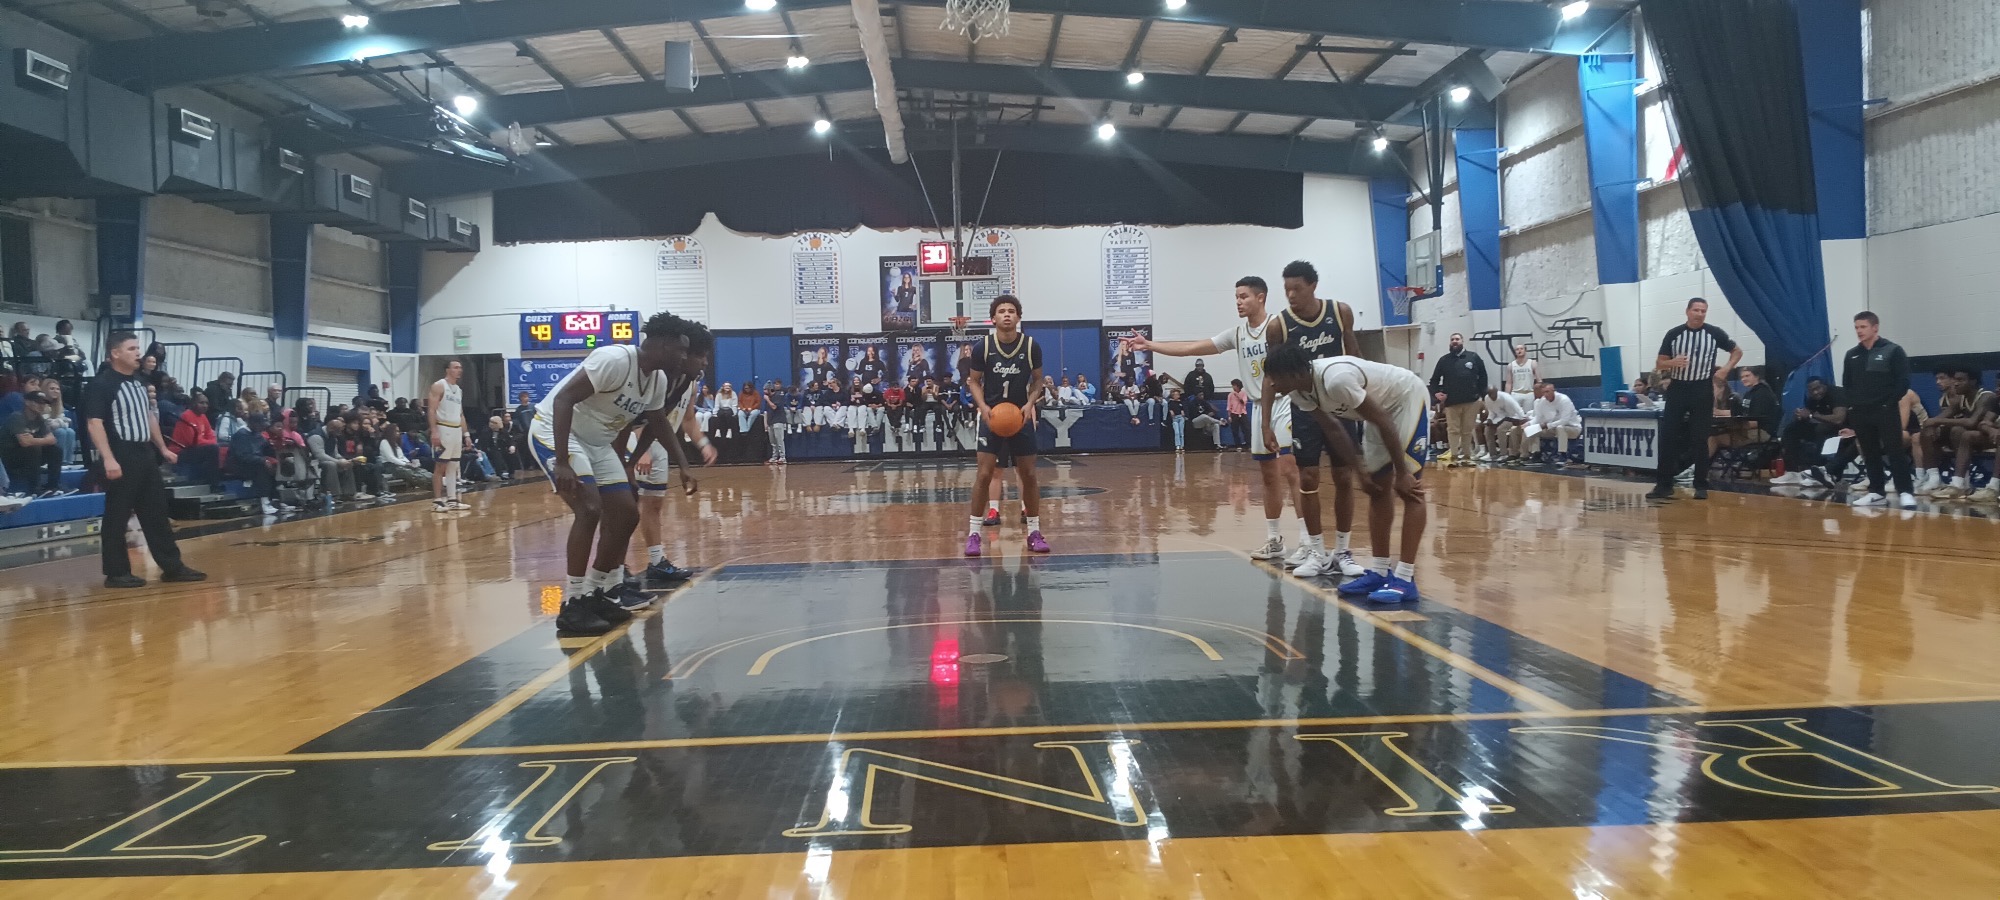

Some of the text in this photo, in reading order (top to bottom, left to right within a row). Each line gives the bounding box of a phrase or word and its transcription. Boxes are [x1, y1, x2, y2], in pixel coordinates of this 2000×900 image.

[798, 234, 833, 244] TRINITY
[975, 230, 1010, 241] TRINITY
[1108, 227, 1143, 238] TRINITY
[923, 245, 947, 264] 30
[530, 324, 552, 341] 49
[612, 322, 633, 339] 66
[586, 334, 596, 347] 2
[1298, 331, 1334, 352] Eagles
[519, 373, 528, 382] C
[550, 373, 559, 382] O
[993, 362, 1020, 378] Eagles
[1002, 380, 1010, 399] 1
[1586, 427, 1656, 457] TRINITY
